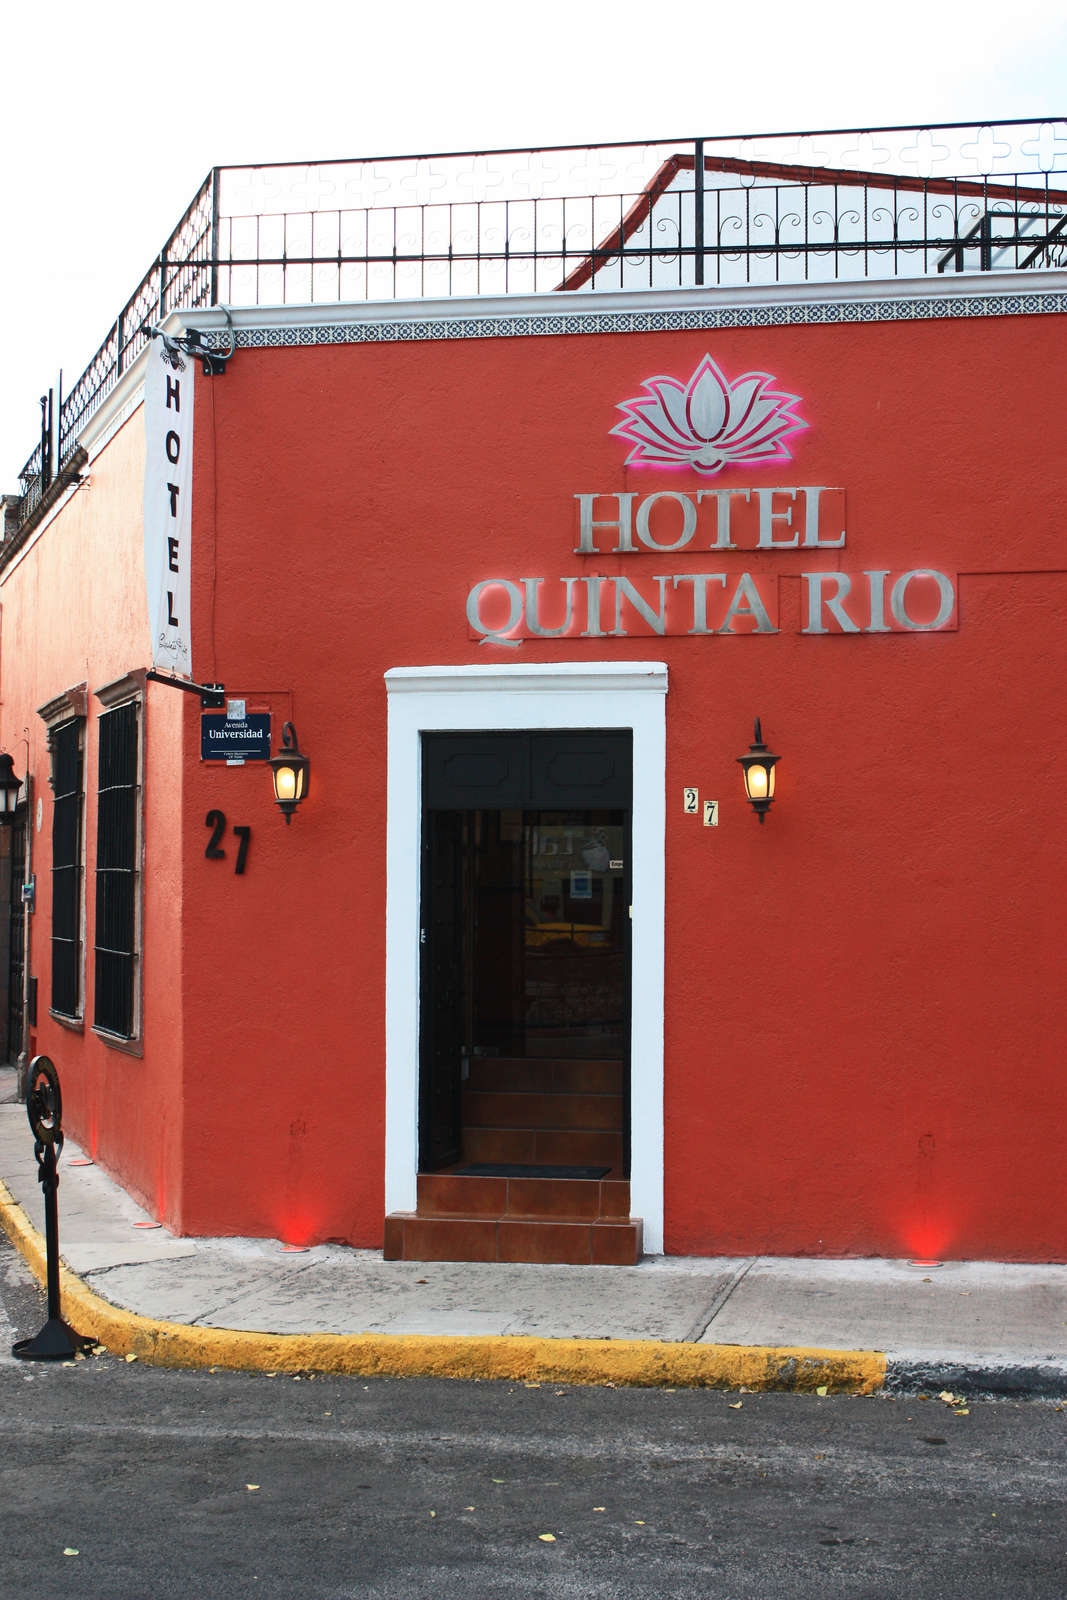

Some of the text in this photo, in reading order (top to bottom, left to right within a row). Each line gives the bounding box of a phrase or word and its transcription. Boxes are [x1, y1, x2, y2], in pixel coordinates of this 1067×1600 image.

[166, 375, 180, 627] HOTEL
[573, 487, 846, 553] HOTEL
[466, 569, 955, 647] QUINTA RIO
[209, 729, 263, 739] Universidad
[205, 809, 250, 875] 27
